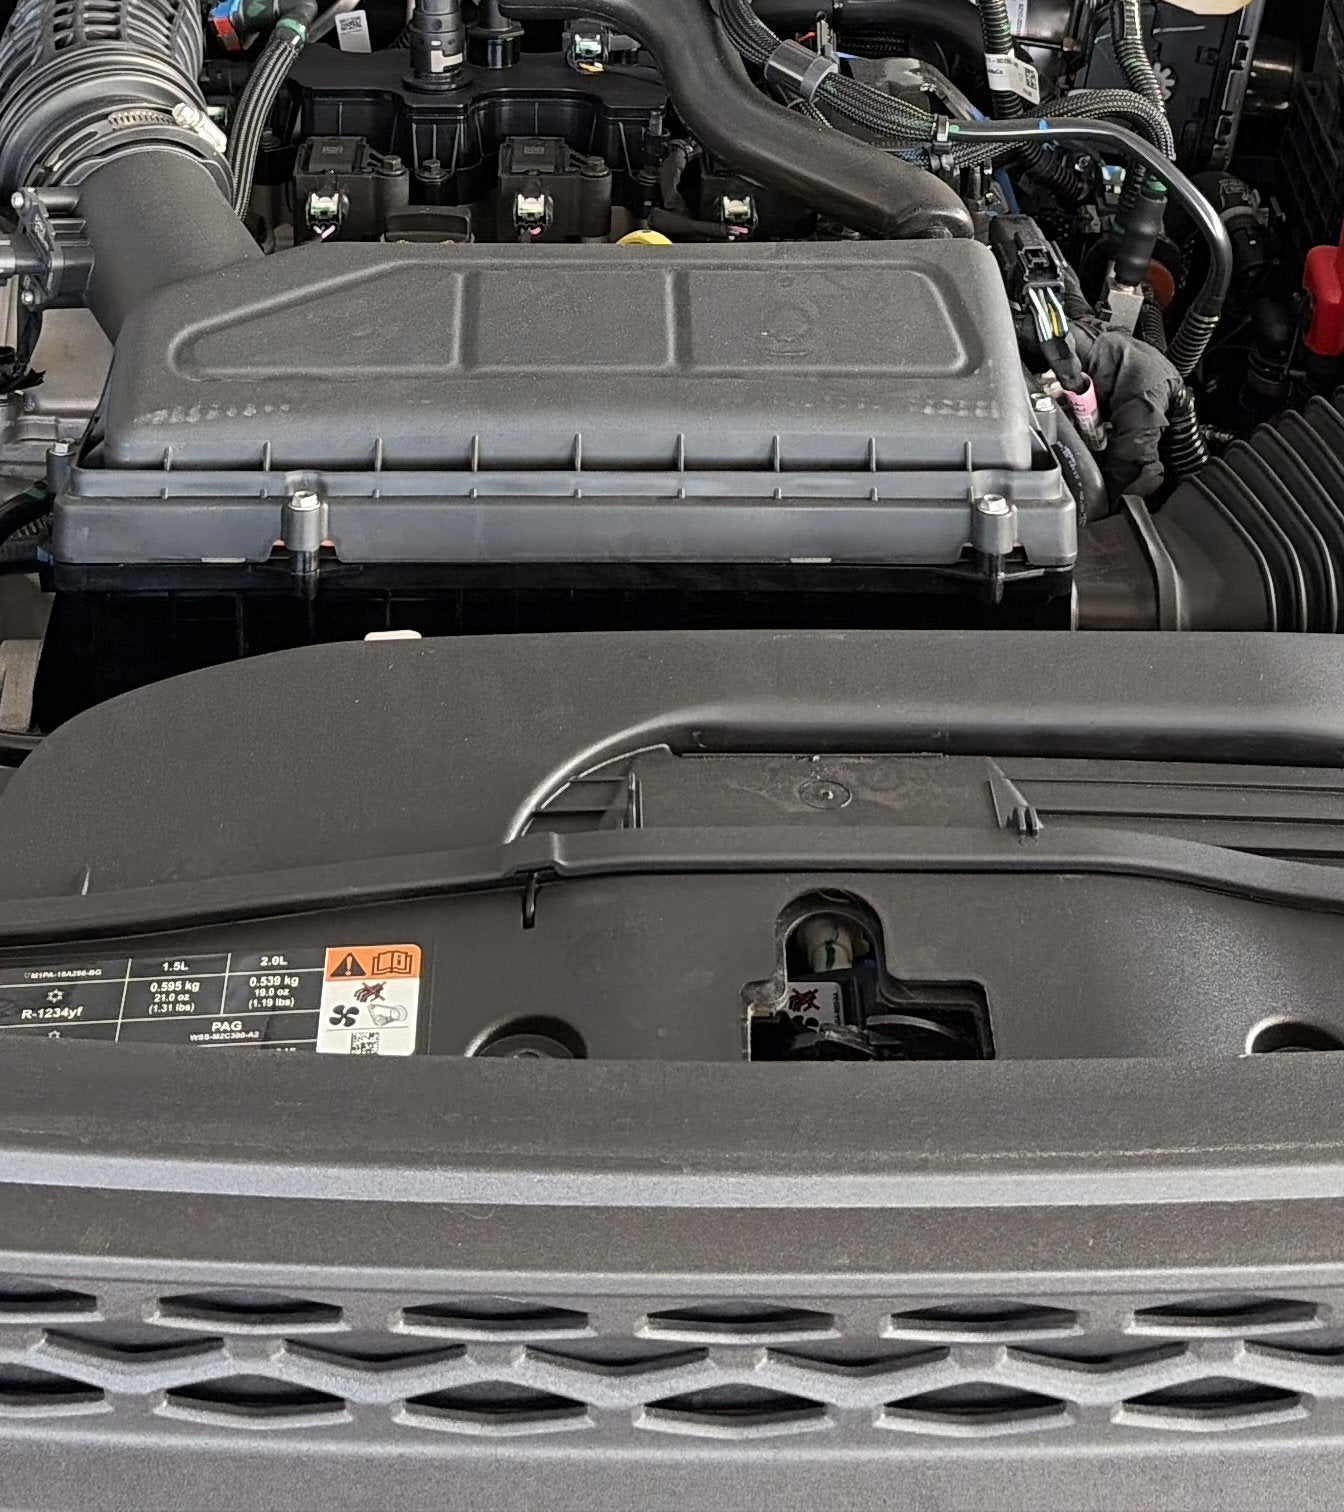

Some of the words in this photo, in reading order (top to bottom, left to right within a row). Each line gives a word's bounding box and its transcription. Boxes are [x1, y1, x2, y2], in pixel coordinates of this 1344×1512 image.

[162, 961, 189, 972] 1.5L
[259, 955, 288, 967] 2.0L
[149, 981, 182, 993] 0.595
[184, 980, 201, 993] kg
[249, 976, 281, 988] 0.539
[284, 974, 300, 987] kg
[153, 992, 175, 1003] 21.0
[254, 988, 275, 997] 19.0
[276, 988, 290, 996] oz
[148, 1002, 173, 1015] (1.31
[175, 1002, 196, 1013] lbs)
[248, 997, 274, 1009] (1.19
[275, 996, 296, 1008] lbs)
[21, 1006, 84, 1020] R-1234yf
[211, 1020, 244, 1032] PAG
